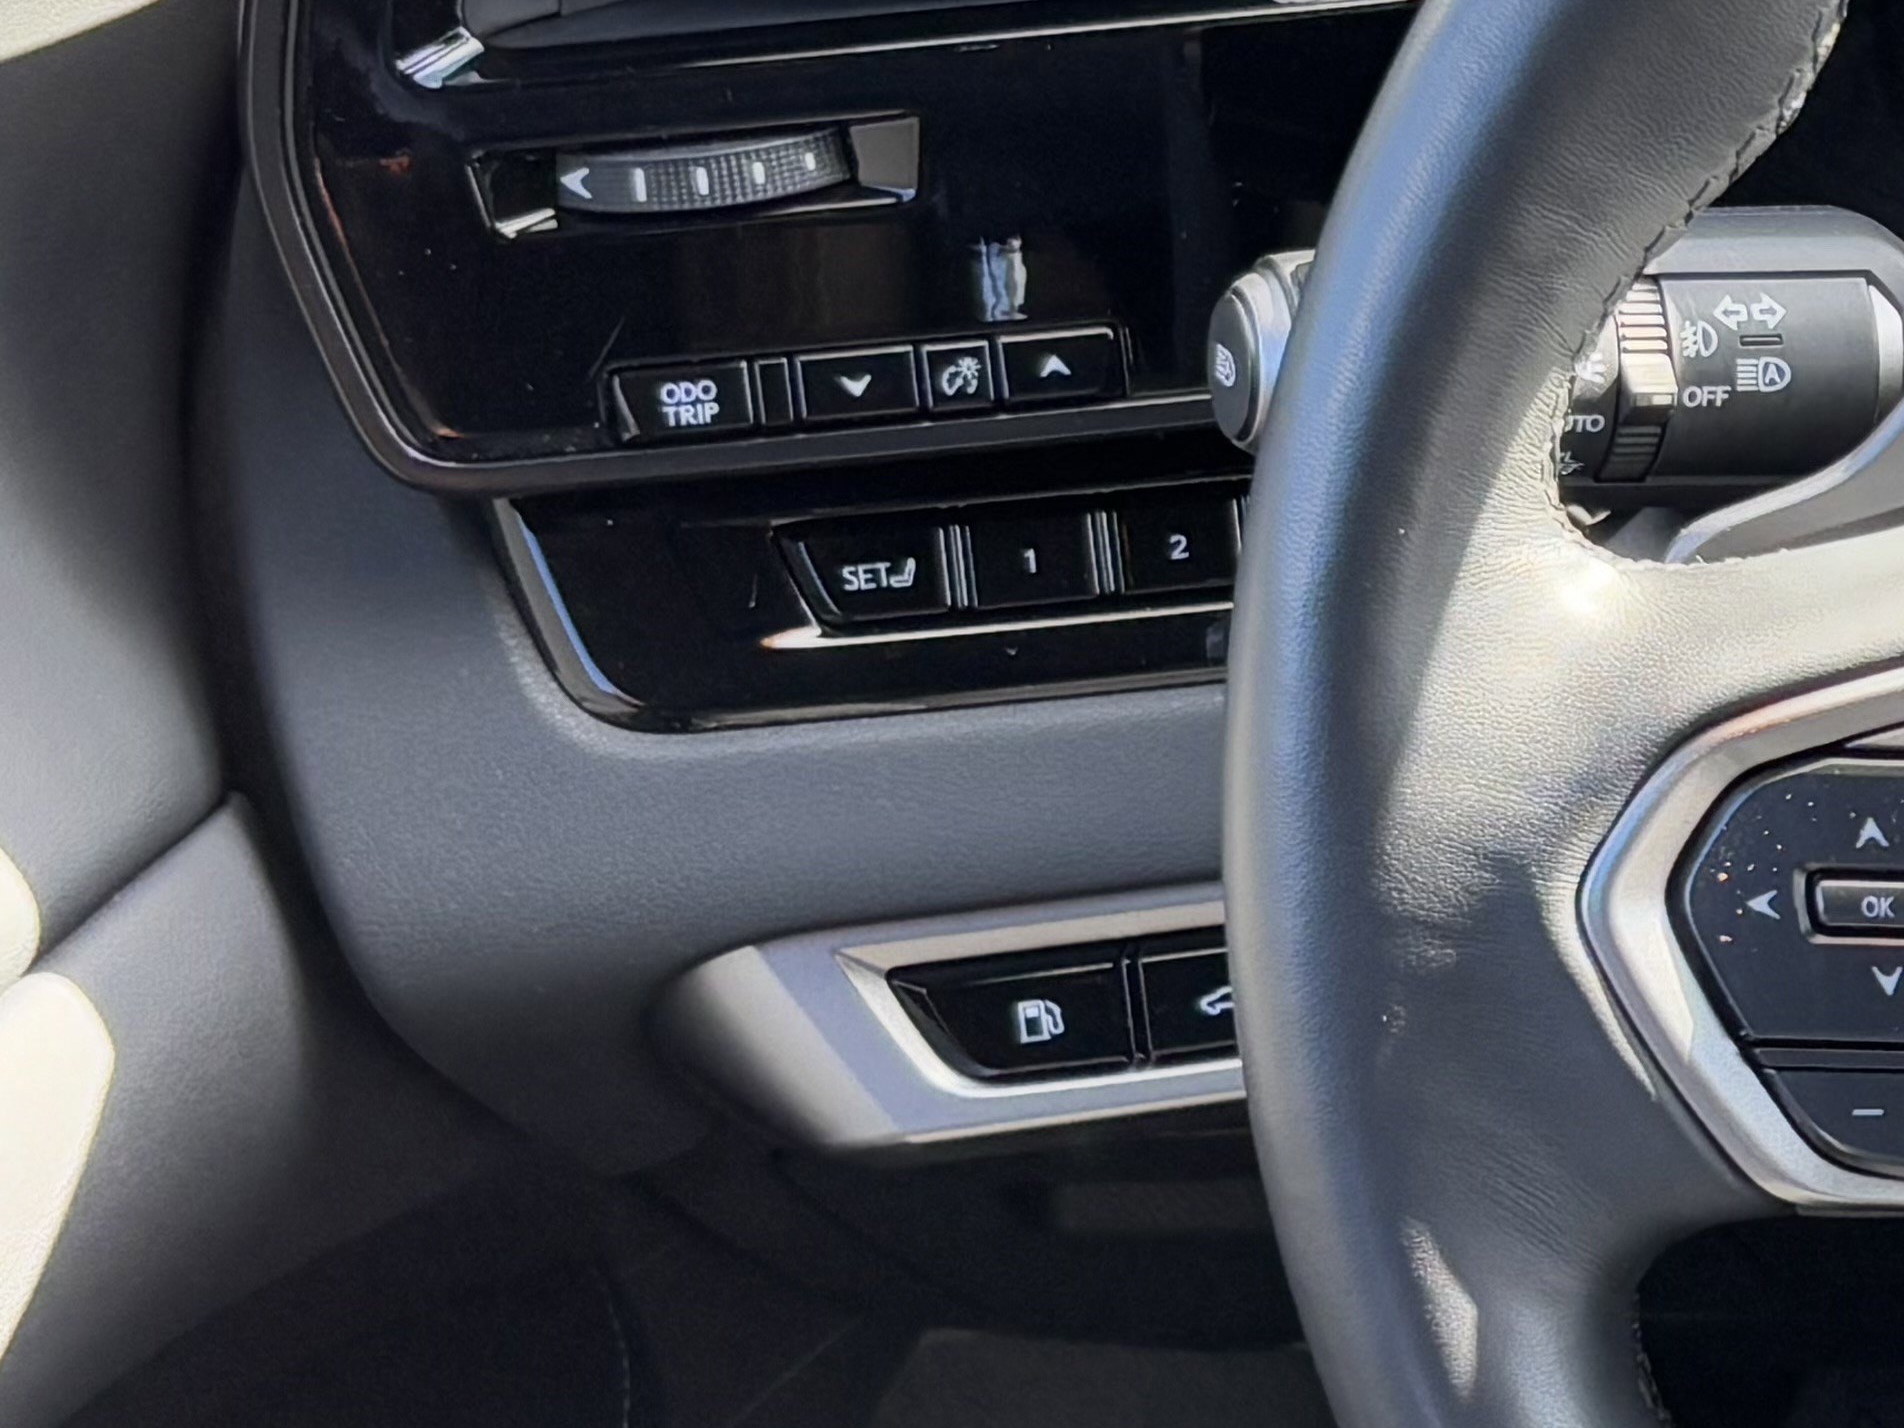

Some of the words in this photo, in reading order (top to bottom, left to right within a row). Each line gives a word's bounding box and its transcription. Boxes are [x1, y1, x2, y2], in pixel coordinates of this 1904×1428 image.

[660, 379, 718, 405] ODO
[1682, 385, 1730, 408] OFF
[661, 401, 720, 427] TRIP
[1169, 534, 1190, 560] 2
[1023, 548, 1037, 574] 1
[841, 563, 890, 591] SET
[1861, 895, 1894, 918] OK
